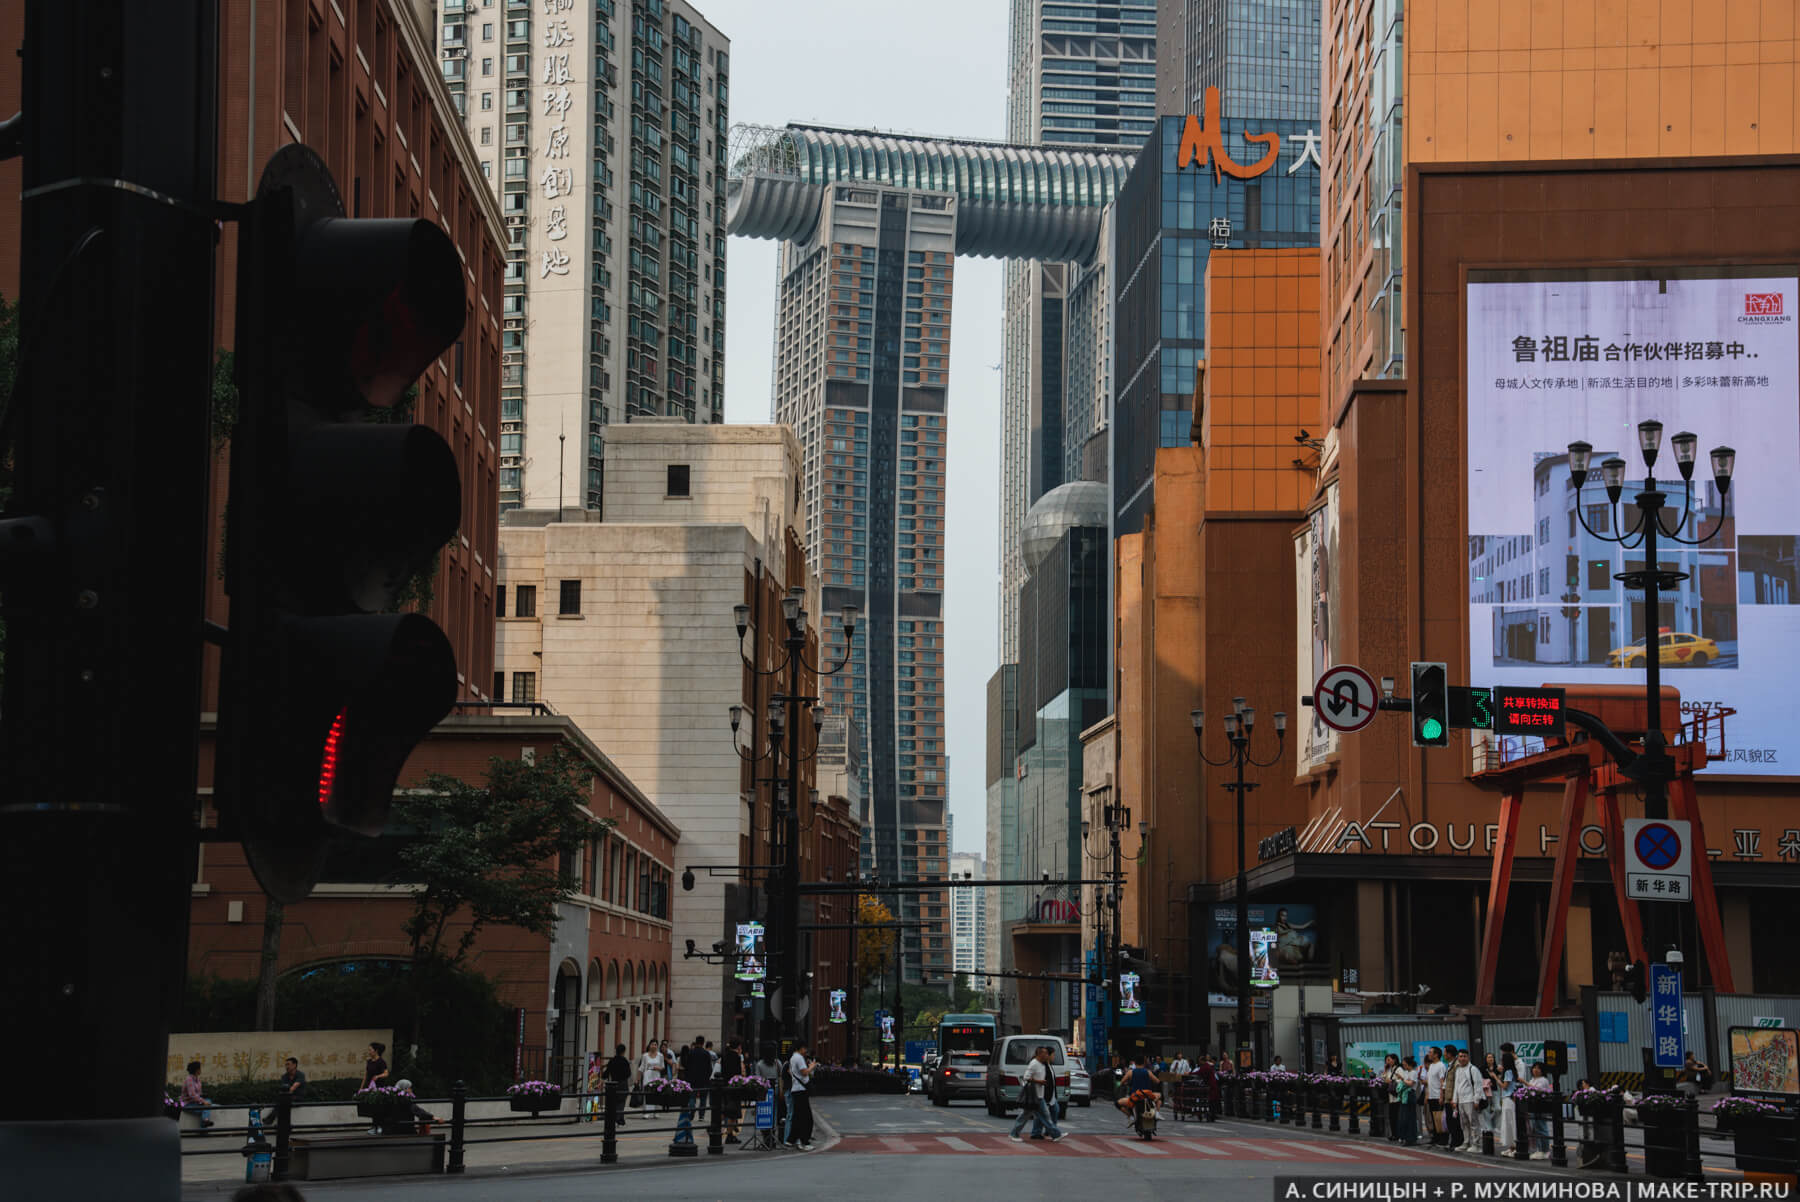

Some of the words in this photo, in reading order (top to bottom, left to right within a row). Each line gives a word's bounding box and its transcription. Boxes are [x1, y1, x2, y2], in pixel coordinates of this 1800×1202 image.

[1737, 315, 1791, 323] CHANGXIANG
[1494, 377, 1579, 390] 母城人文传承地
[1586, 376, 1673, 390] 新派生活目的地
[1681, 375, 1770, 389] 多彩味蕾新高地
[1471, 689, 1491, 729] 3
[1503, 696, 1560, 711] 共享转换道
[1508, 712, 1555, 726] 请向左转
[1635, 878, 1683, 894] 新华路
[1656, 974, 1680, 1057] 新华路
